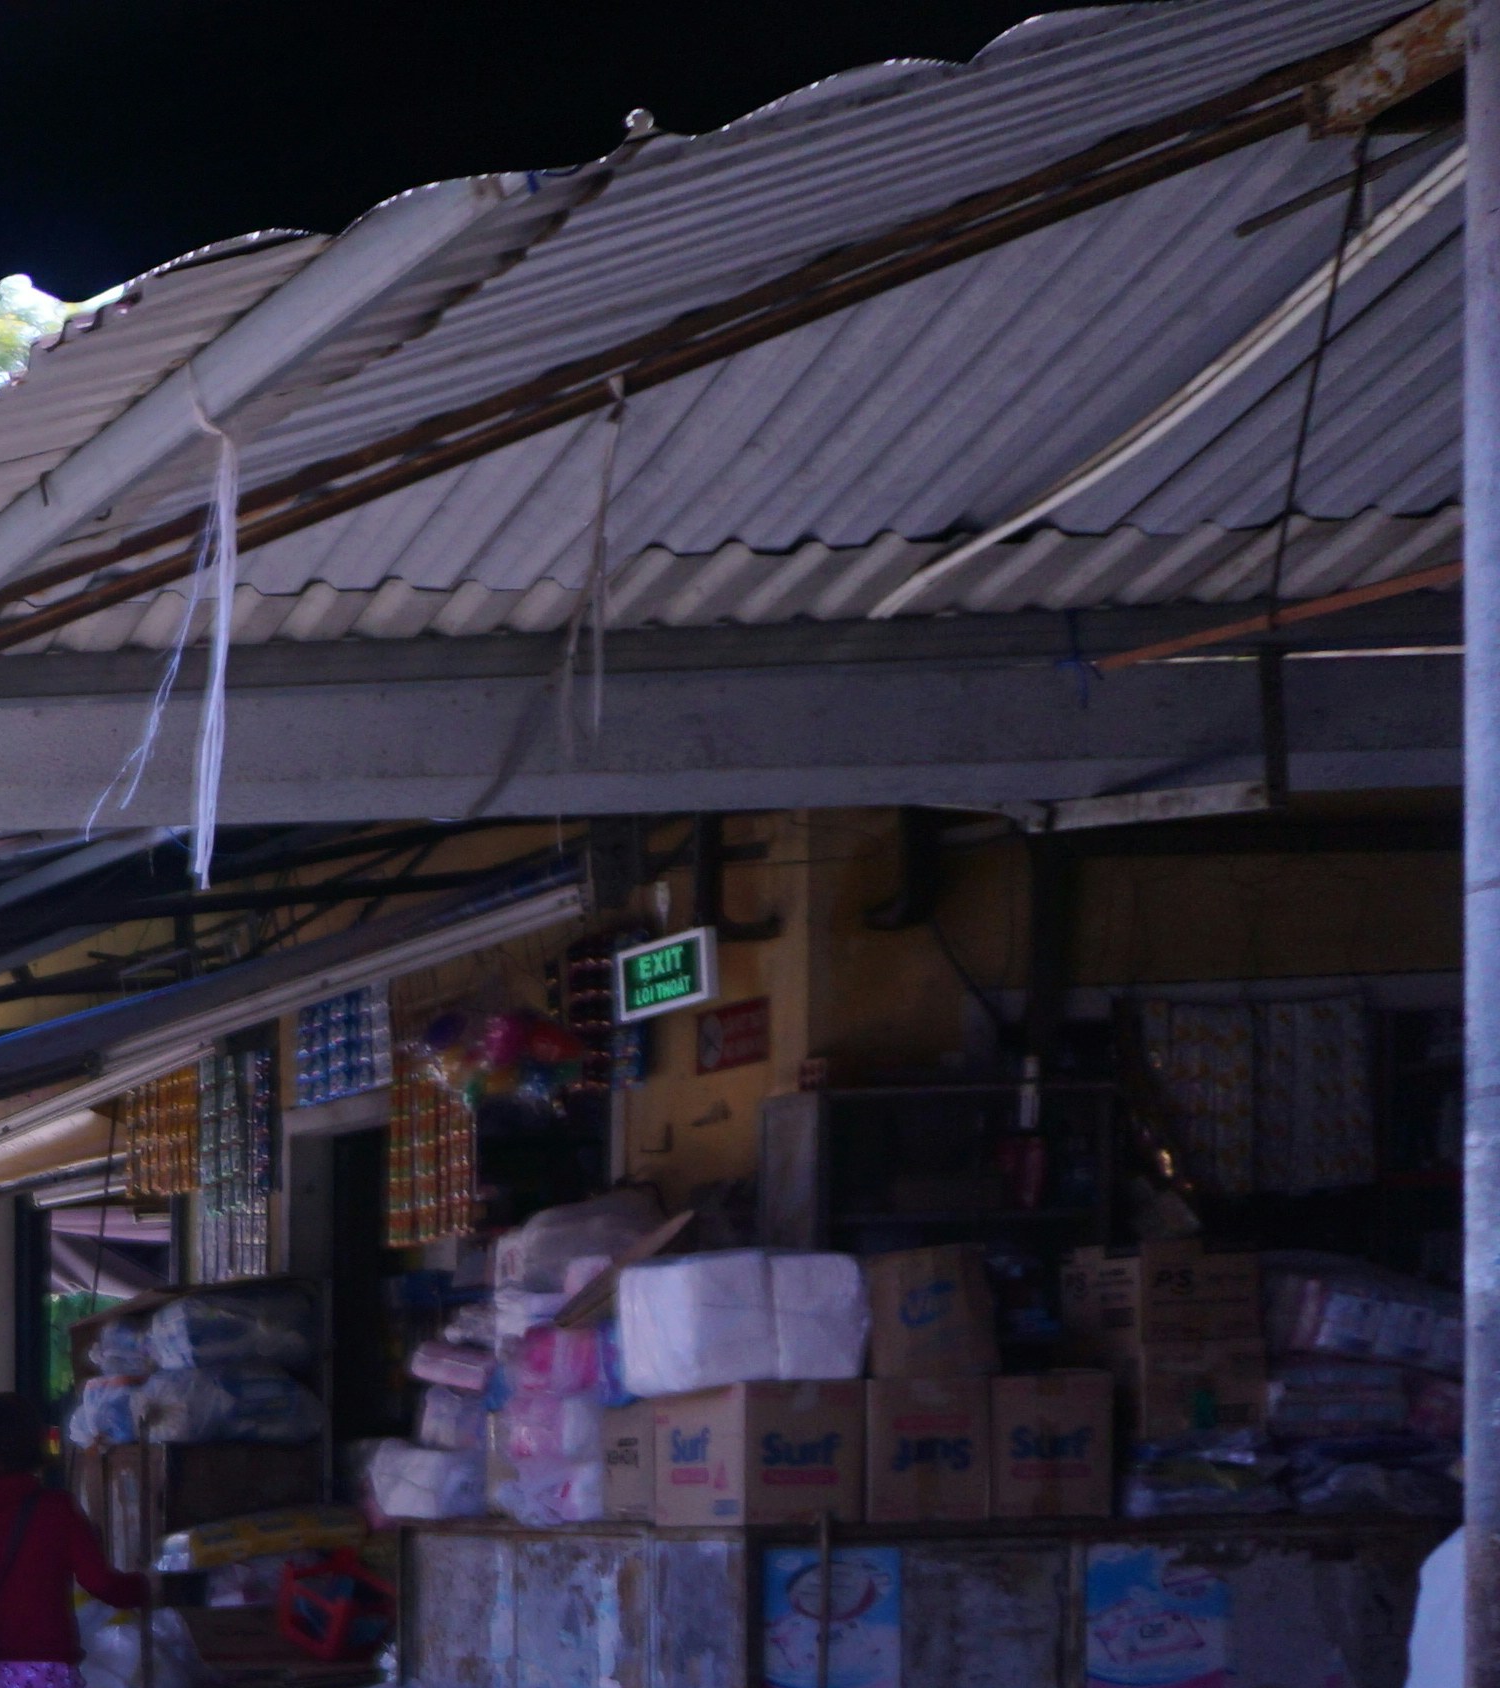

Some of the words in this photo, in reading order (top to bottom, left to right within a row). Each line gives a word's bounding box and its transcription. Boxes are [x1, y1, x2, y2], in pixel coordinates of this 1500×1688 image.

[639, 945, 685, 980] EXIT
[671, 1427, 711, 1464] Surf
[761, 1431, 842, 1468] Surf
[1011, 1425, 1095, 1462] Surf
